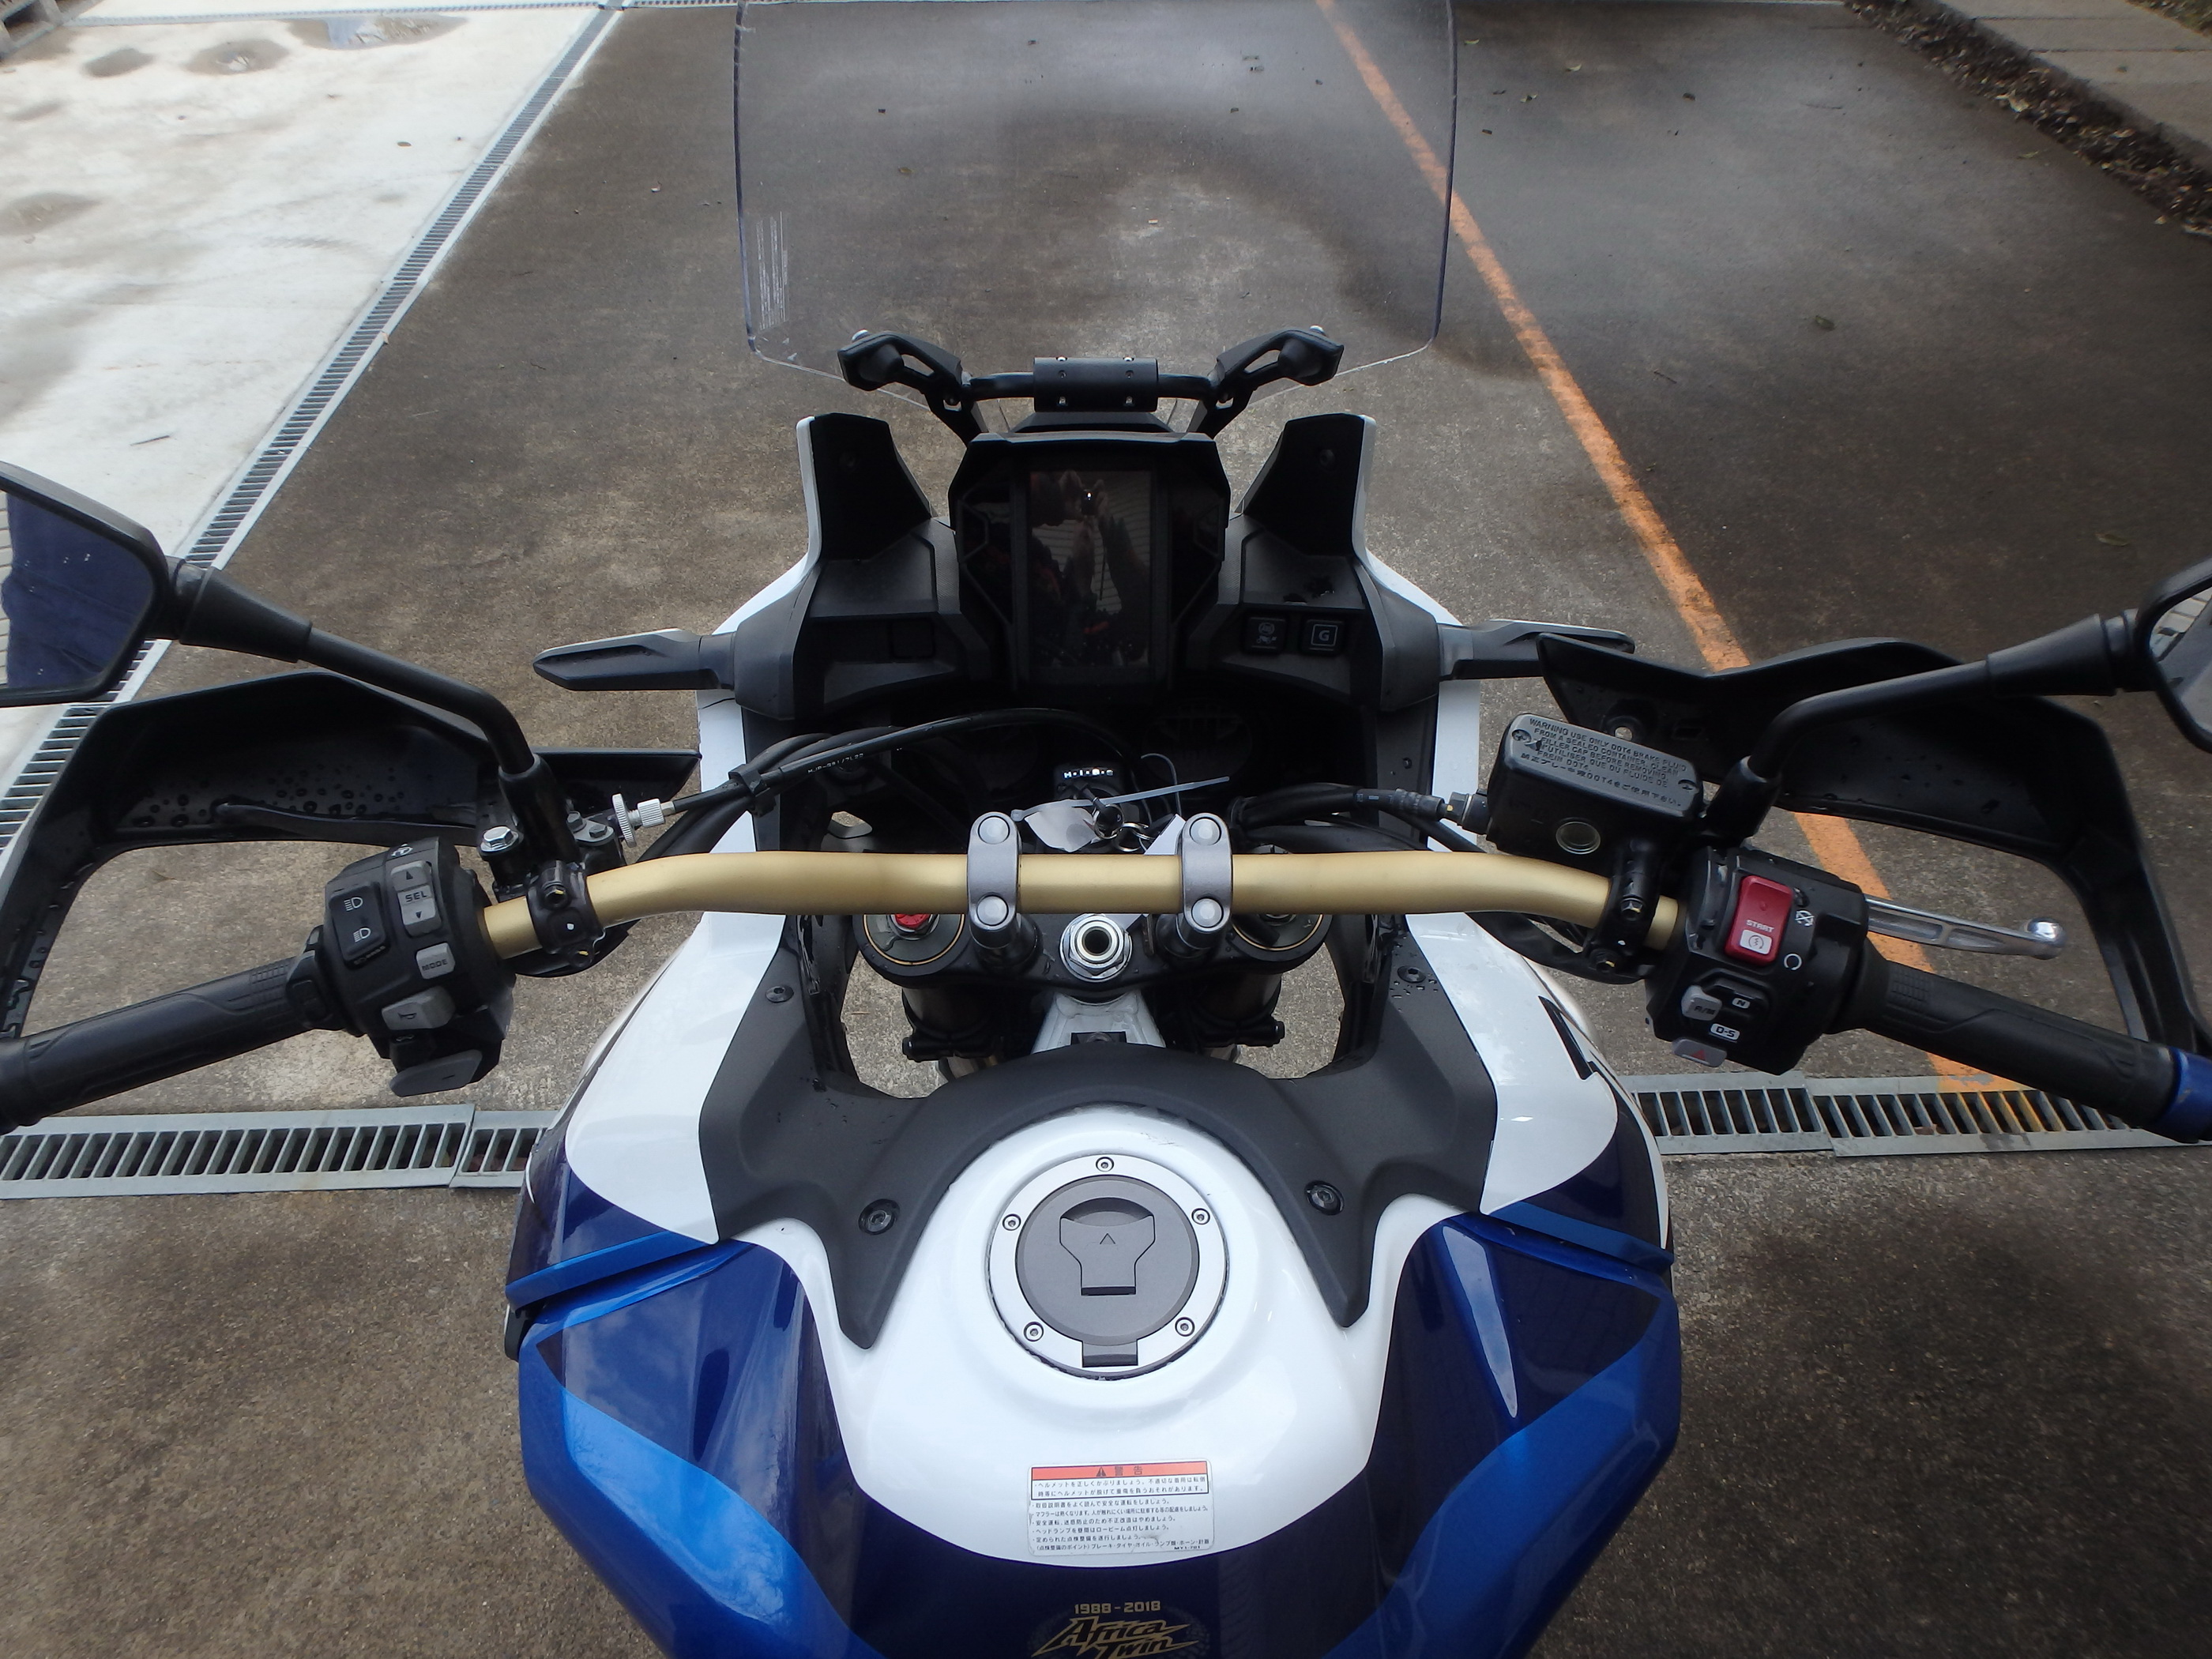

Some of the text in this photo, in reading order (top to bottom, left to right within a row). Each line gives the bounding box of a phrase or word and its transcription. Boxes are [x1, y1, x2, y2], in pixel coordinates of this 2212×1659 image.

[1318, 630, 1330, 641] G
[1529, 717, 1687, 771] WARNING USE ONLY DOT4 BRAKE FLUID
[1540, 736, 1570, 750] FILLER
[1571, 746, 1588, 755] CAP
[1589, 751, 1623, 766] BEFORE
[1534, 728, 1556, 739] FROM
[1565, 737, 1598, 751] SEALED
[1650, 762, 1678, 776] CLEAN
[1537, 750, 1563, 762] FREIN
[1589, 758, 1606, 769] QUE
[1608, 764, 1620, 773] DU
[1623, 769, 1653, 783] FLUIDE
[1656, 779, 1668, 788] DE
[404, 890, 427, 903] SEL
[1745, 919, 1775, 933] START
[421, 958, 448, 972] MODE
[1716, 1025, 1736, 1037] D-S
